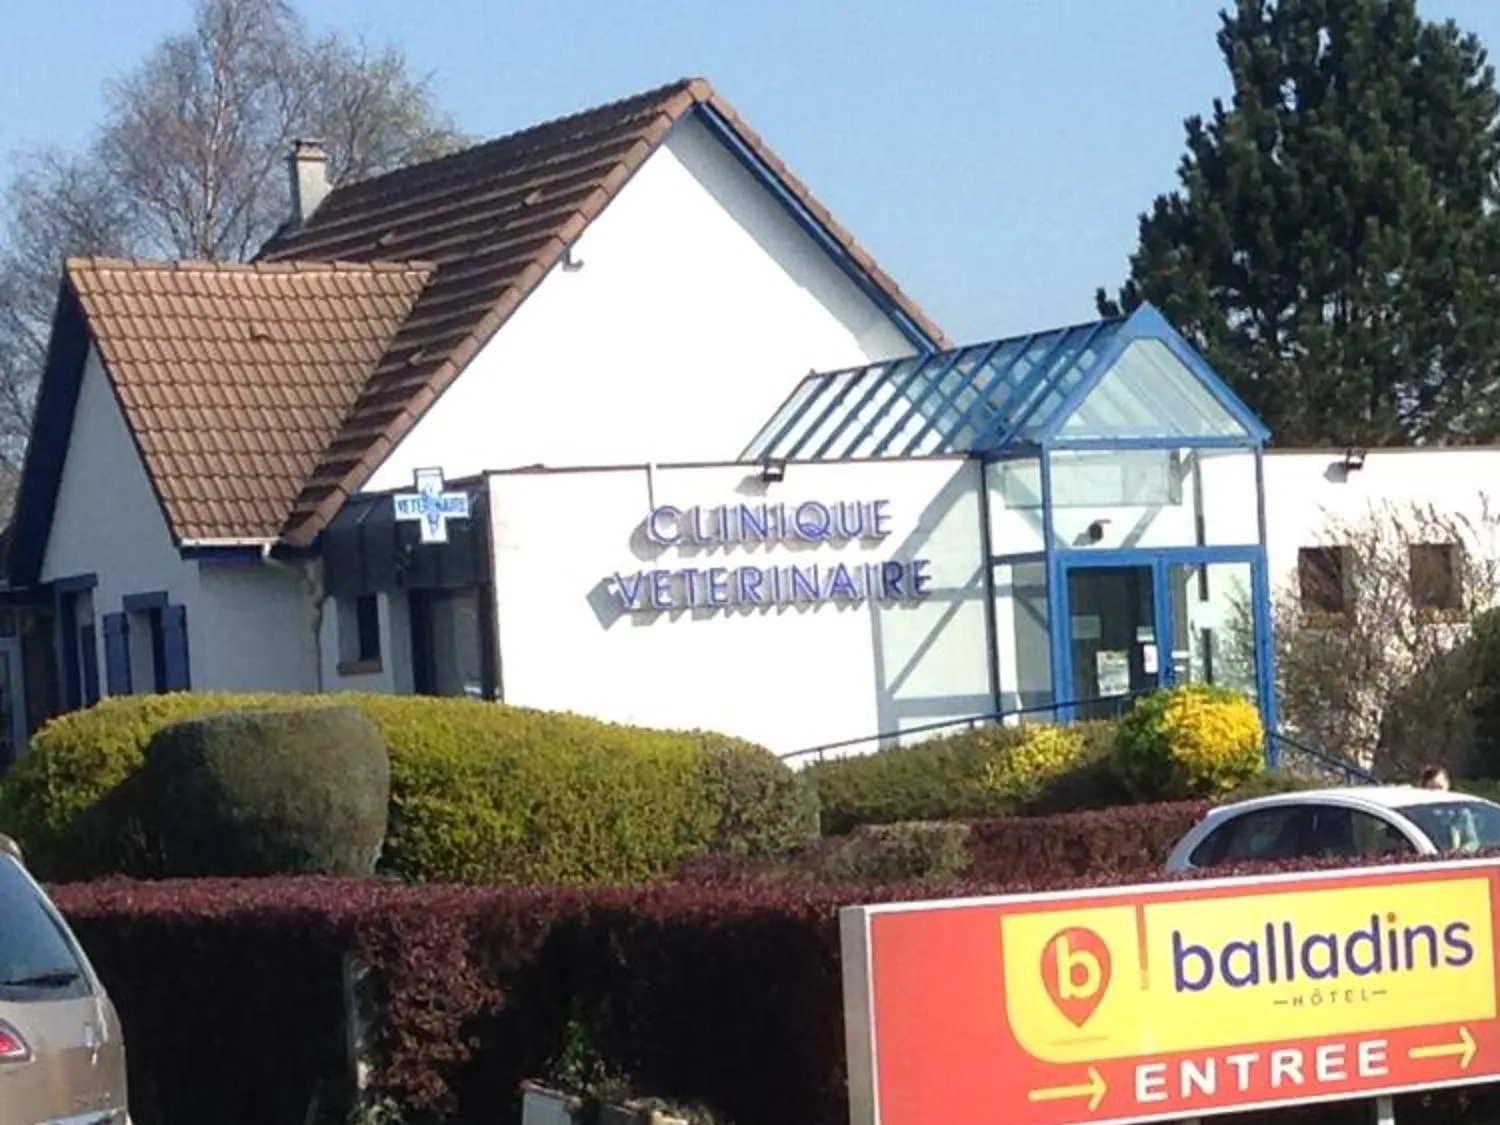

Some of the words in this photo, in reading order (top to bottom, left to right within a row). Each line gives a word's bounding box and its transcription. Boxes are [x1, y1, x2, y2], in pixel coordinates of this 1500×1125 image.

[647, 500, 895, 546] CLINIQUE
[613, 559, 932, 609] VETERINAIRE
[1056, 935, 1102, 999] b
[1172, 912, 1474, 993] balladins
[1134, 1039, 1390, 1103] ENTREE
